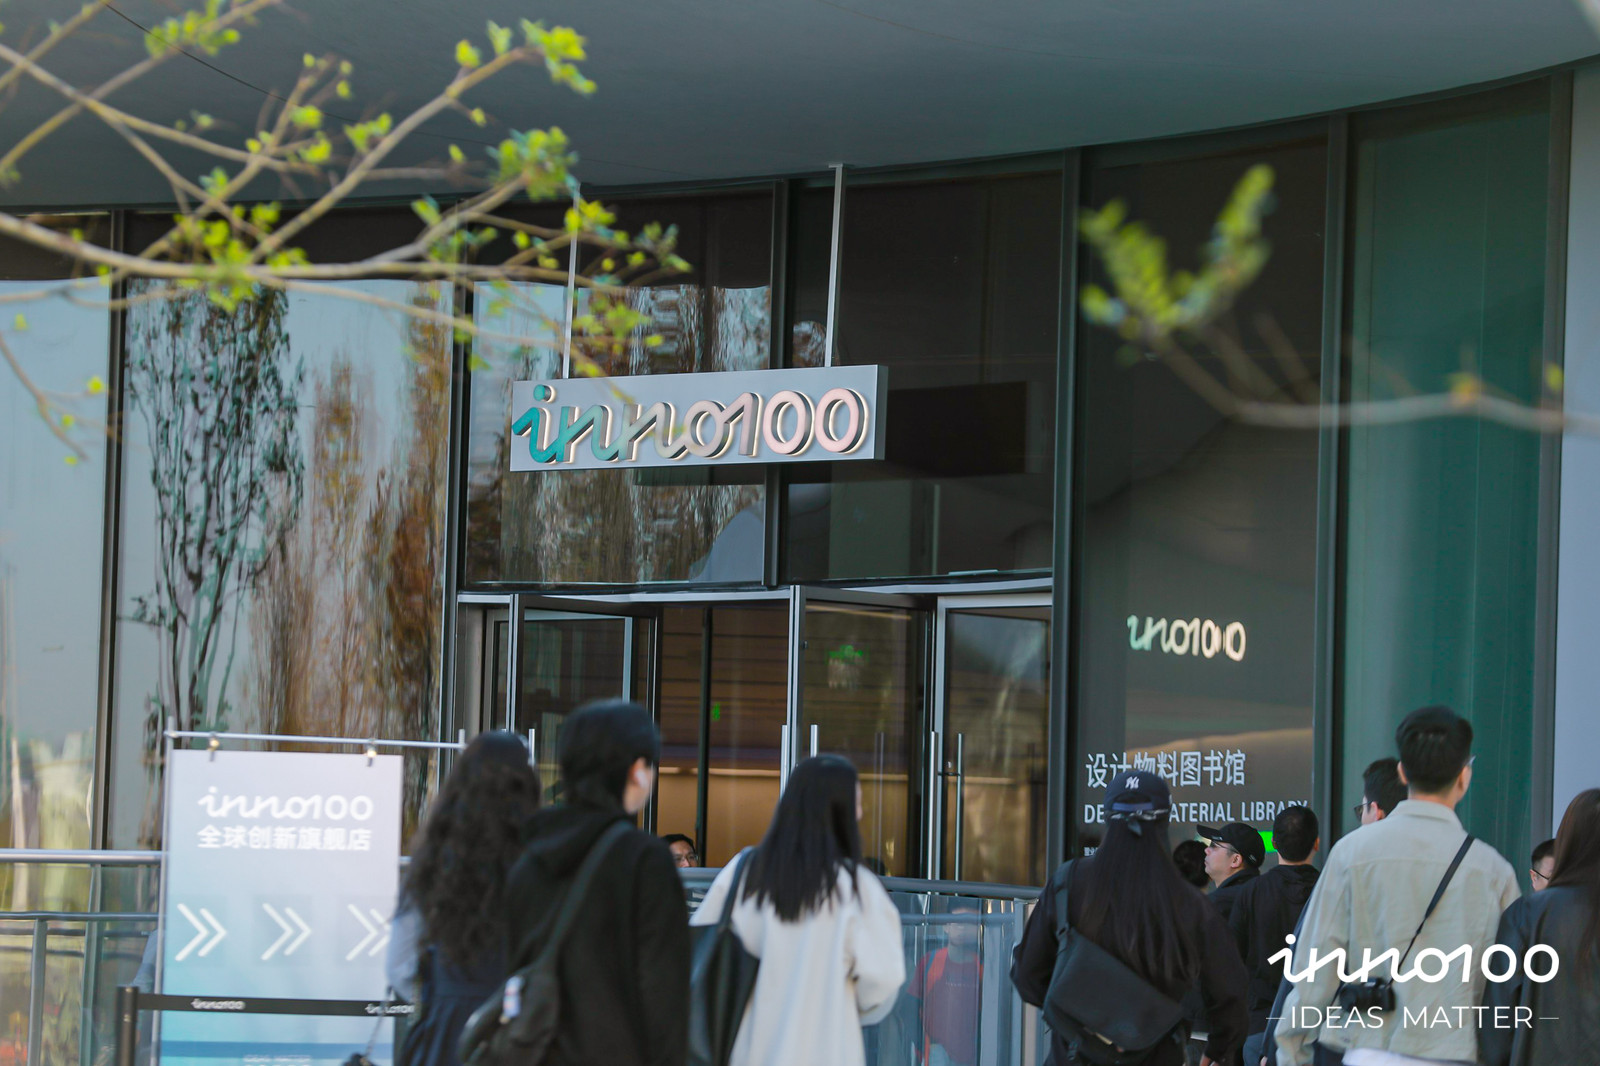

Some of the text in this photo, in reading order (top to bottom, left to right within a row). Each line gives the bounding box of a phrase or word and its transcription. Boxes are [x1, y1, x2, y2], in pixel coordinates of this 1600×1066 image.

[511, 384, 868, 463] inno100
[197, 785, 374, 821] inno100
[1168, 803, 1235, 823] ATERIAL
[197, 824, 373, 851] 全球创新旗舰店
